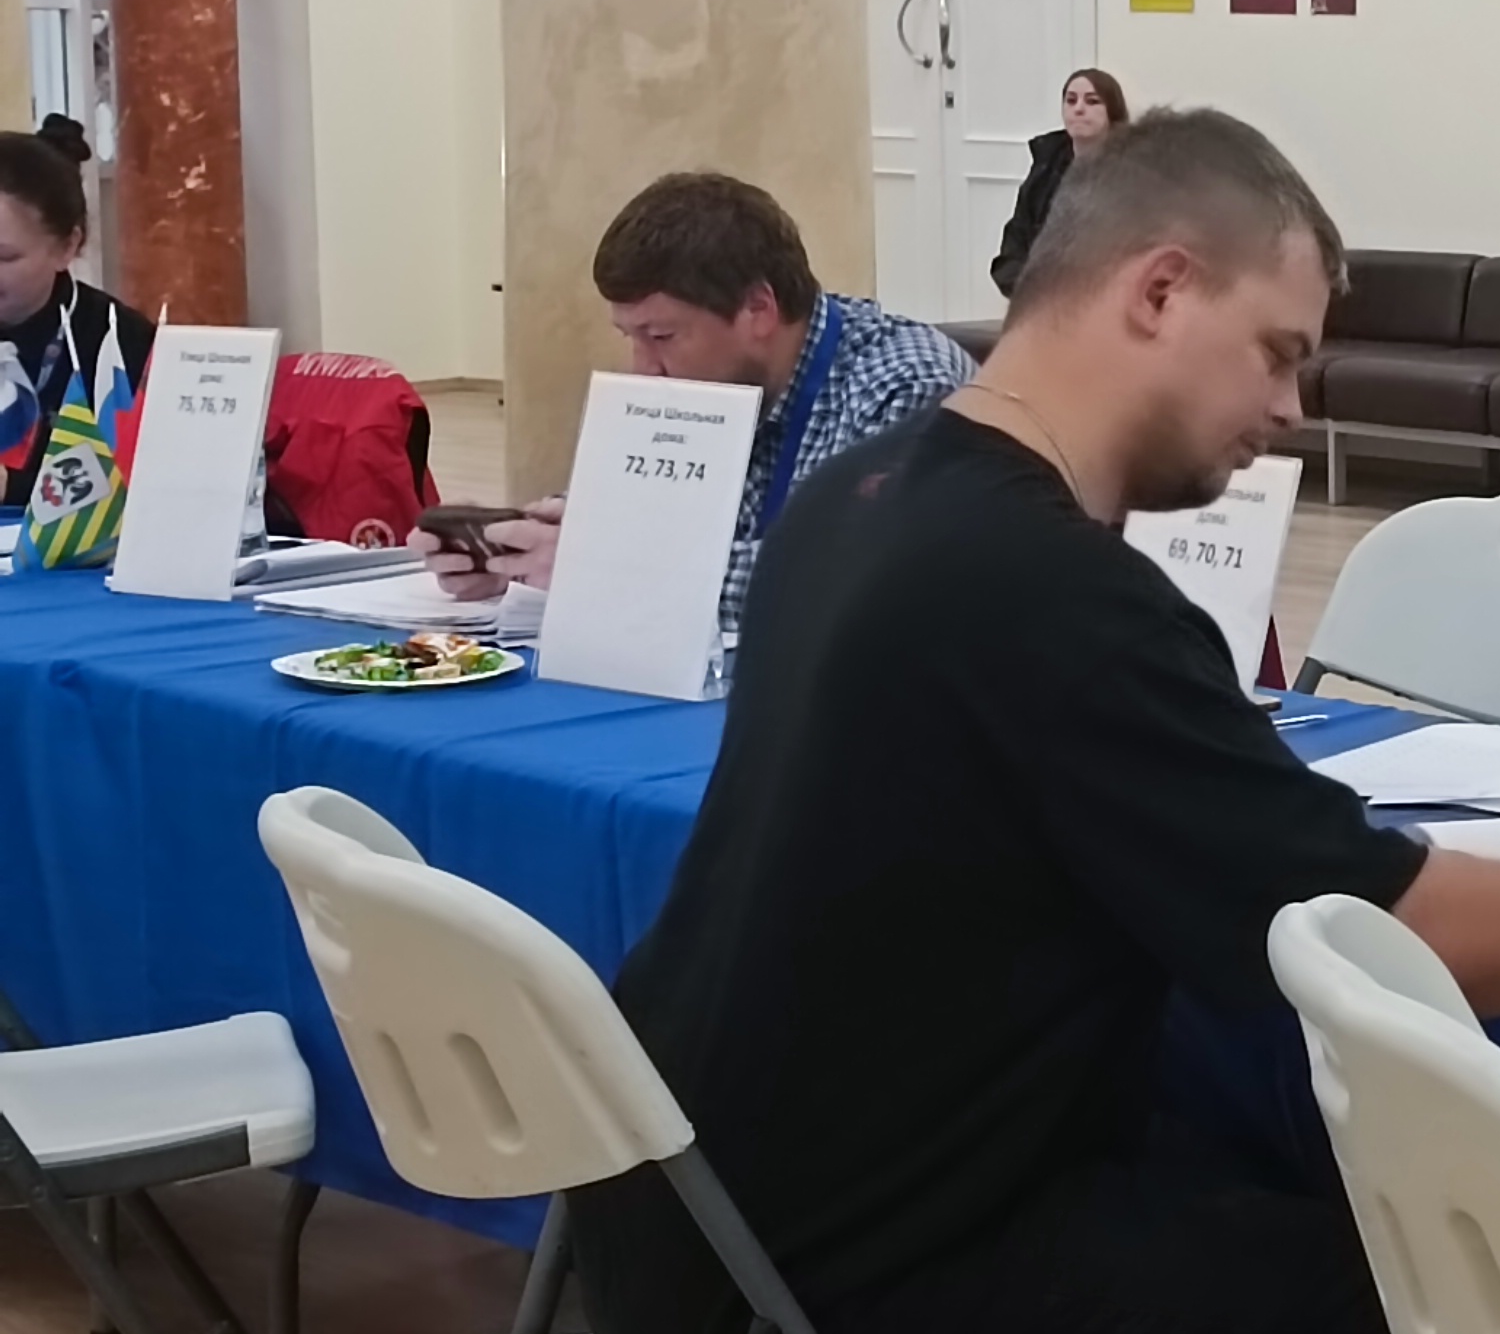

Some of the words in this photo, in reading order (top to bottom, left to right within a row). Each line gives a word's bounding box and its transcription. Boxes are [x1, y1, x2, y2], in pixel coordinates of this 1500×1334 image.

[179, 395, 195, 414] 75,
[200, 396, 217, 415] 76,
[221, 397, 236, 414] 79
[625, 454, 648, 478] 72,
[654, 458, 678, 481] 73,
[685, 461, 706, 481] 74
[1168, 537, 1190, 564] 69,
[1196, 541, 1218, 567] 70,
[1224, 546, 1243, 568] 71
